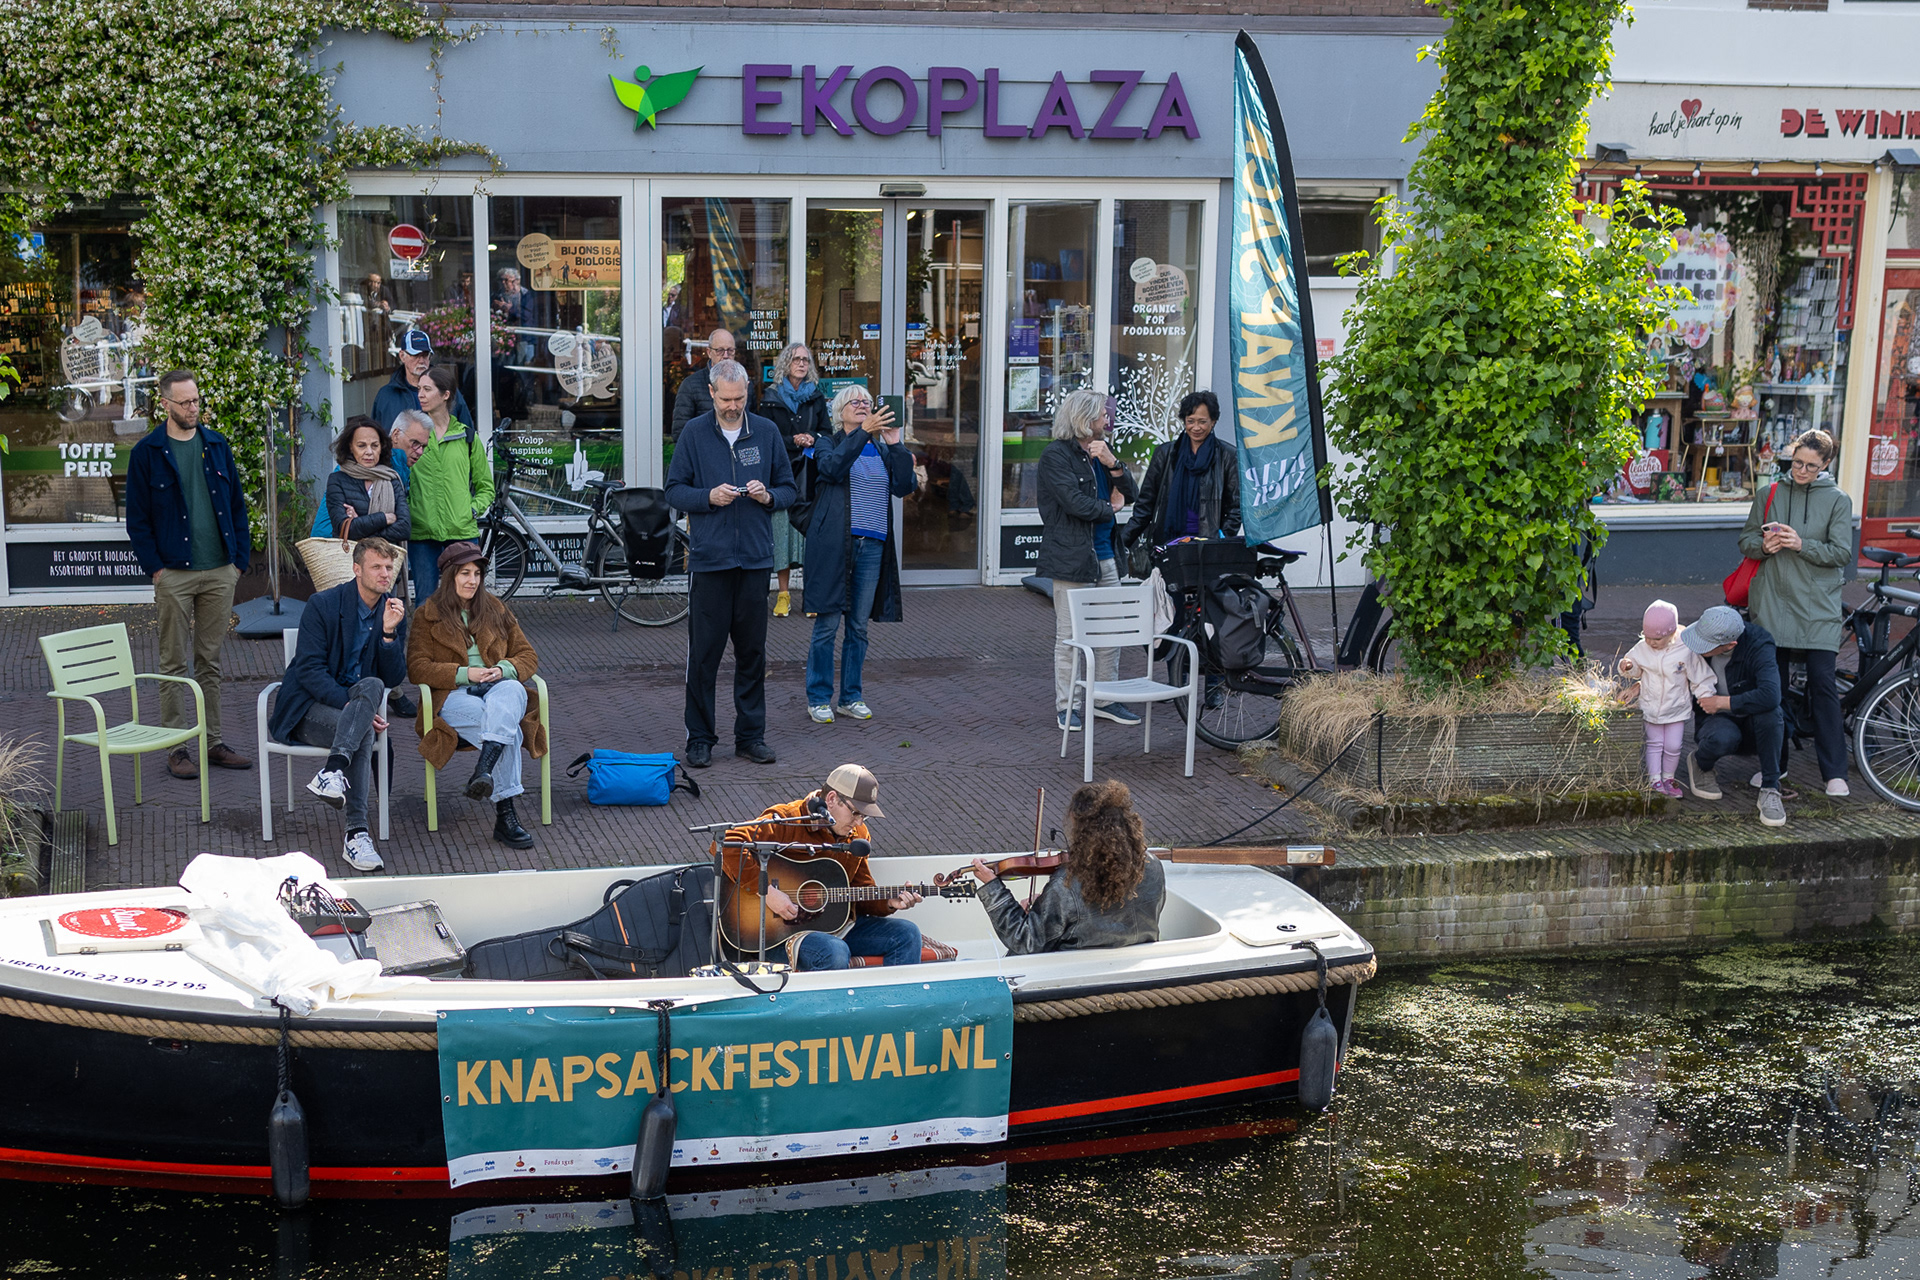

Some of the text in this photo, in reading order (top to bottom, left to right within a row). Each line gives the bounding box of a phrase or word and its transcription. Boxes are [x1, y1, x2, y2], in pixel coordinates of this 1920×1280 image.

[743, 63, 1201, 139] EKOPLAZA
[1648, 104, 1743, 138] haal je hart op in
[1780, 108, 1829, 138] DE
[561, 246, 577, 256] BIJ
[578, 245, 600, 256] ONS
[601, 246, 611, 256] IS
[1132, 303, 1177, 314] ORGANIC
[750, 310, 765, 320] NEEM
[1145, 315, 1166, 325] FOR
[753, 320, 774, 330] GRATIS
[750, 330, 779, 340] MAGAZINE
[1123, 326, 1187, 336] FOODLOVERS
[518, 436, 544, 445] Volop
[58, 442, 117, 460] TOFFE
[542, 457, 554, 465] de
[64, 461, 113, 478] PEER
[558, 538, 581, 549] WERELD
[53, 550, 66, 562] HET
[68, 550, 102, 562] GROOTSTE
[563, 549, 583, 560] GEVEN
[49, 565, 146, 577] ASSORTIMENT VAN NEDERLA
[528, 562, 541, 572] AAN
[123, 977, 148, 985] 99
[152, 980, 178, 988] 27
[183, 982, 208, 990] 95
[455, 1024, 998, 1107] KNAPSACKFESTIVAL.NL
